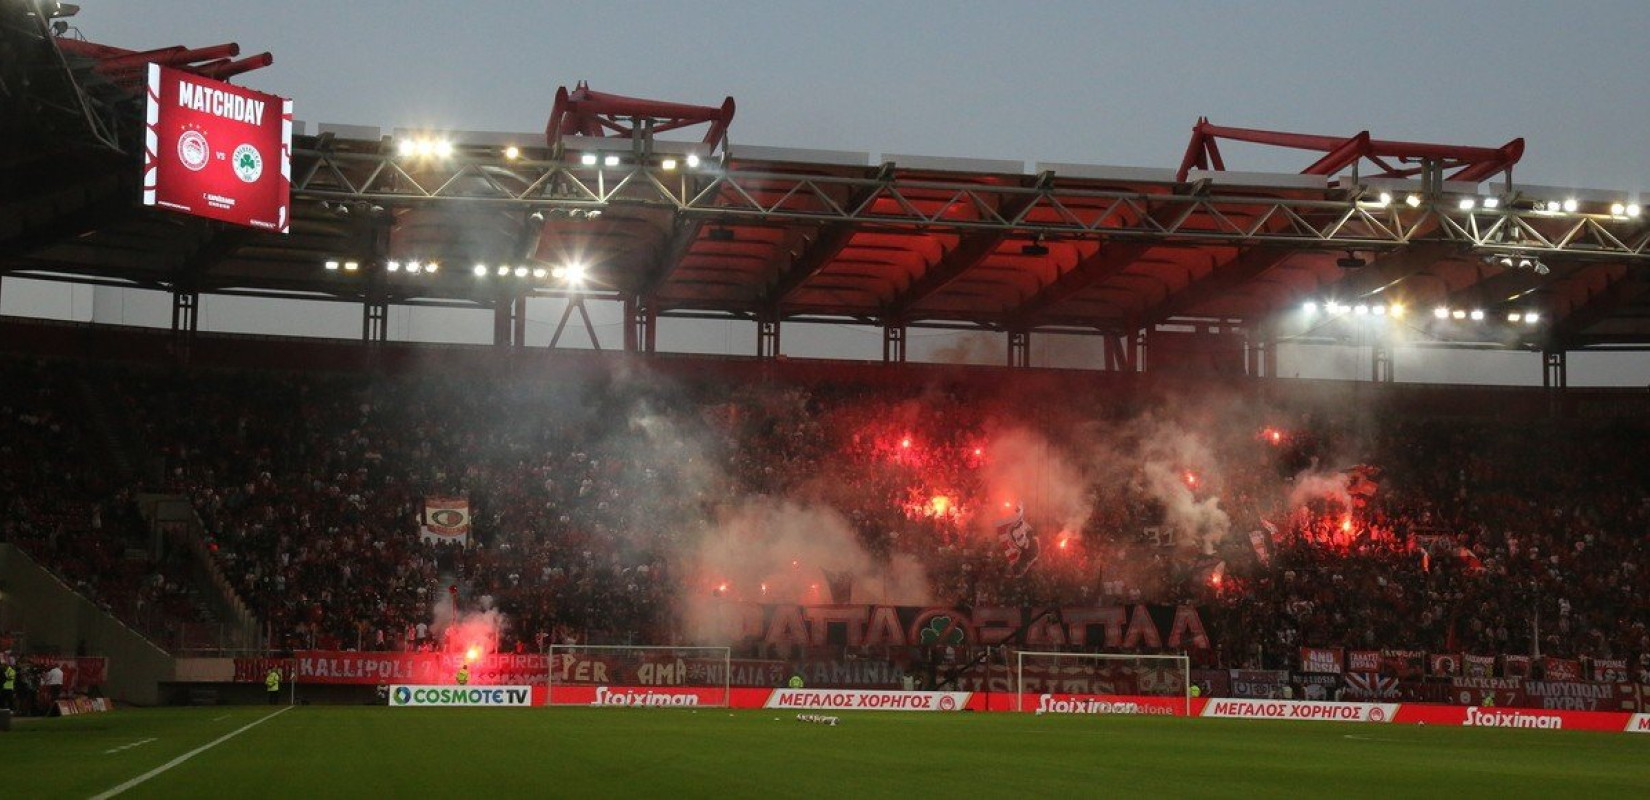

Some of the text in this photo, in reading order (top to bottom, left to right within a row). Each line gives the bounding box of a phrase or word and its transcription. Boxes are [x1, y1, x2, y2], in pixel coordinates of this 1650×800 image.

[179, 81, 264, 126] MATCHDAY
[301, 658, 413, 678] KALLIPOLI
[413, 689, 528, 704] COSMOTE TV
[590, 686, 699, 707] Stoiximan
[778, 693, 932, 709] ΜΕΓΑΛΟΣ ΧΟΡΗΓΟΣ
[1214, 702, 1363, 719] ΜΕΓΑΛΟΣ ΧΟΡΗΓΟΣ
[1463, 706, 1563, 729] Stoiximan
